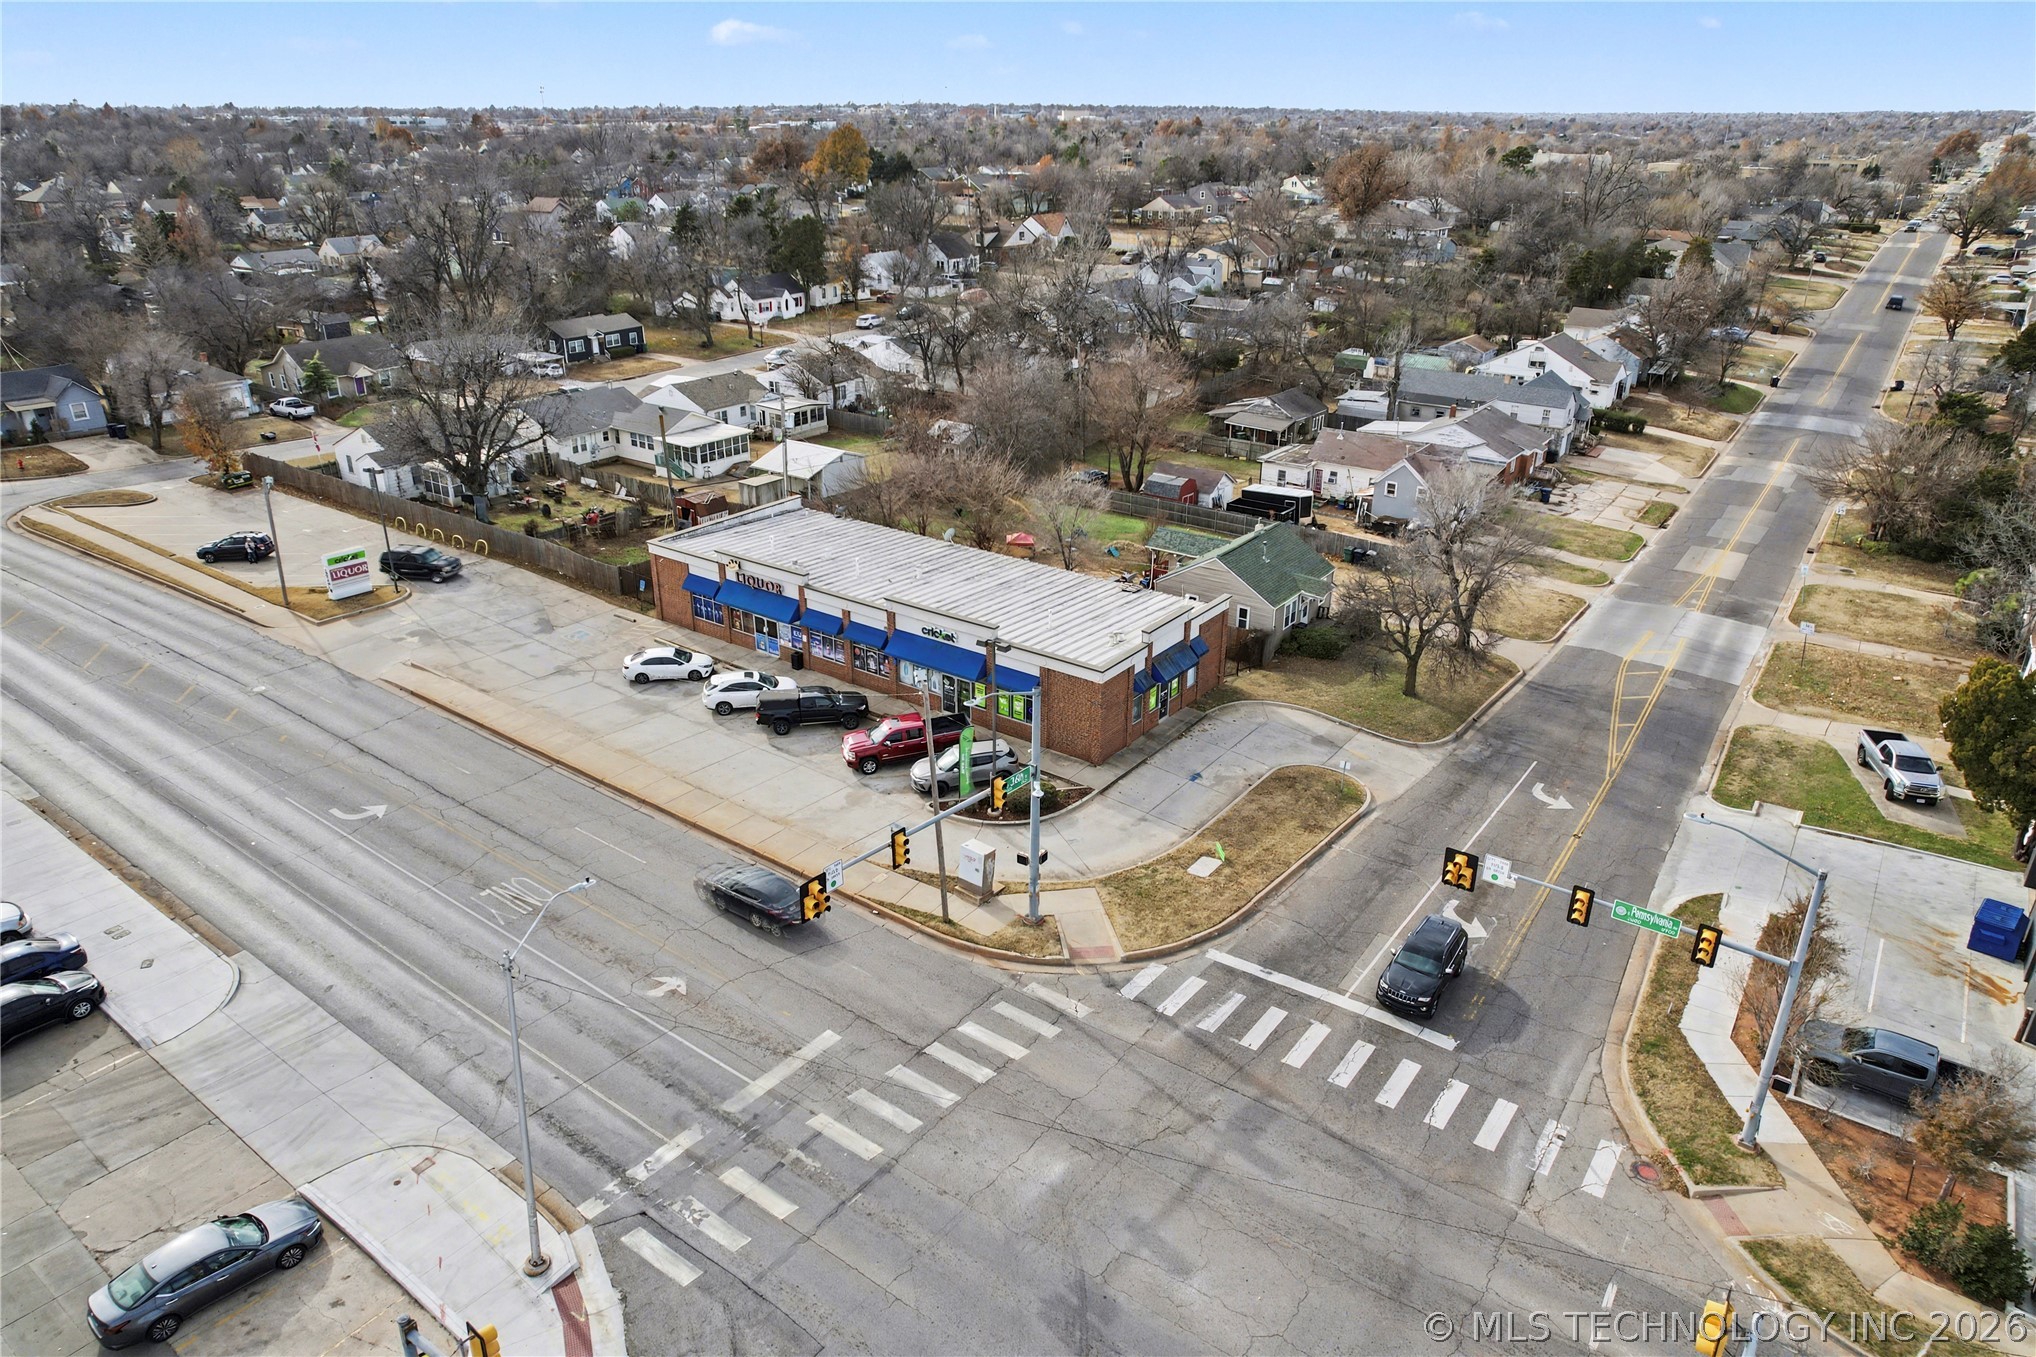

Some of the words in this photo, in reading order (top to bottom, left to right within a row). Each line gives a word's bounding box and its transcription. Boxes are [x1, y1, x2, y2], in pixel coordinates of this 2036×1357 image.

[331, 563, 369, 580] LIQUOR
[735, 571, 784, 596] LIQUOR
[470, 877, 553, 926] ONLY
[1630, 906, 1674, 929] Pennsylvania
